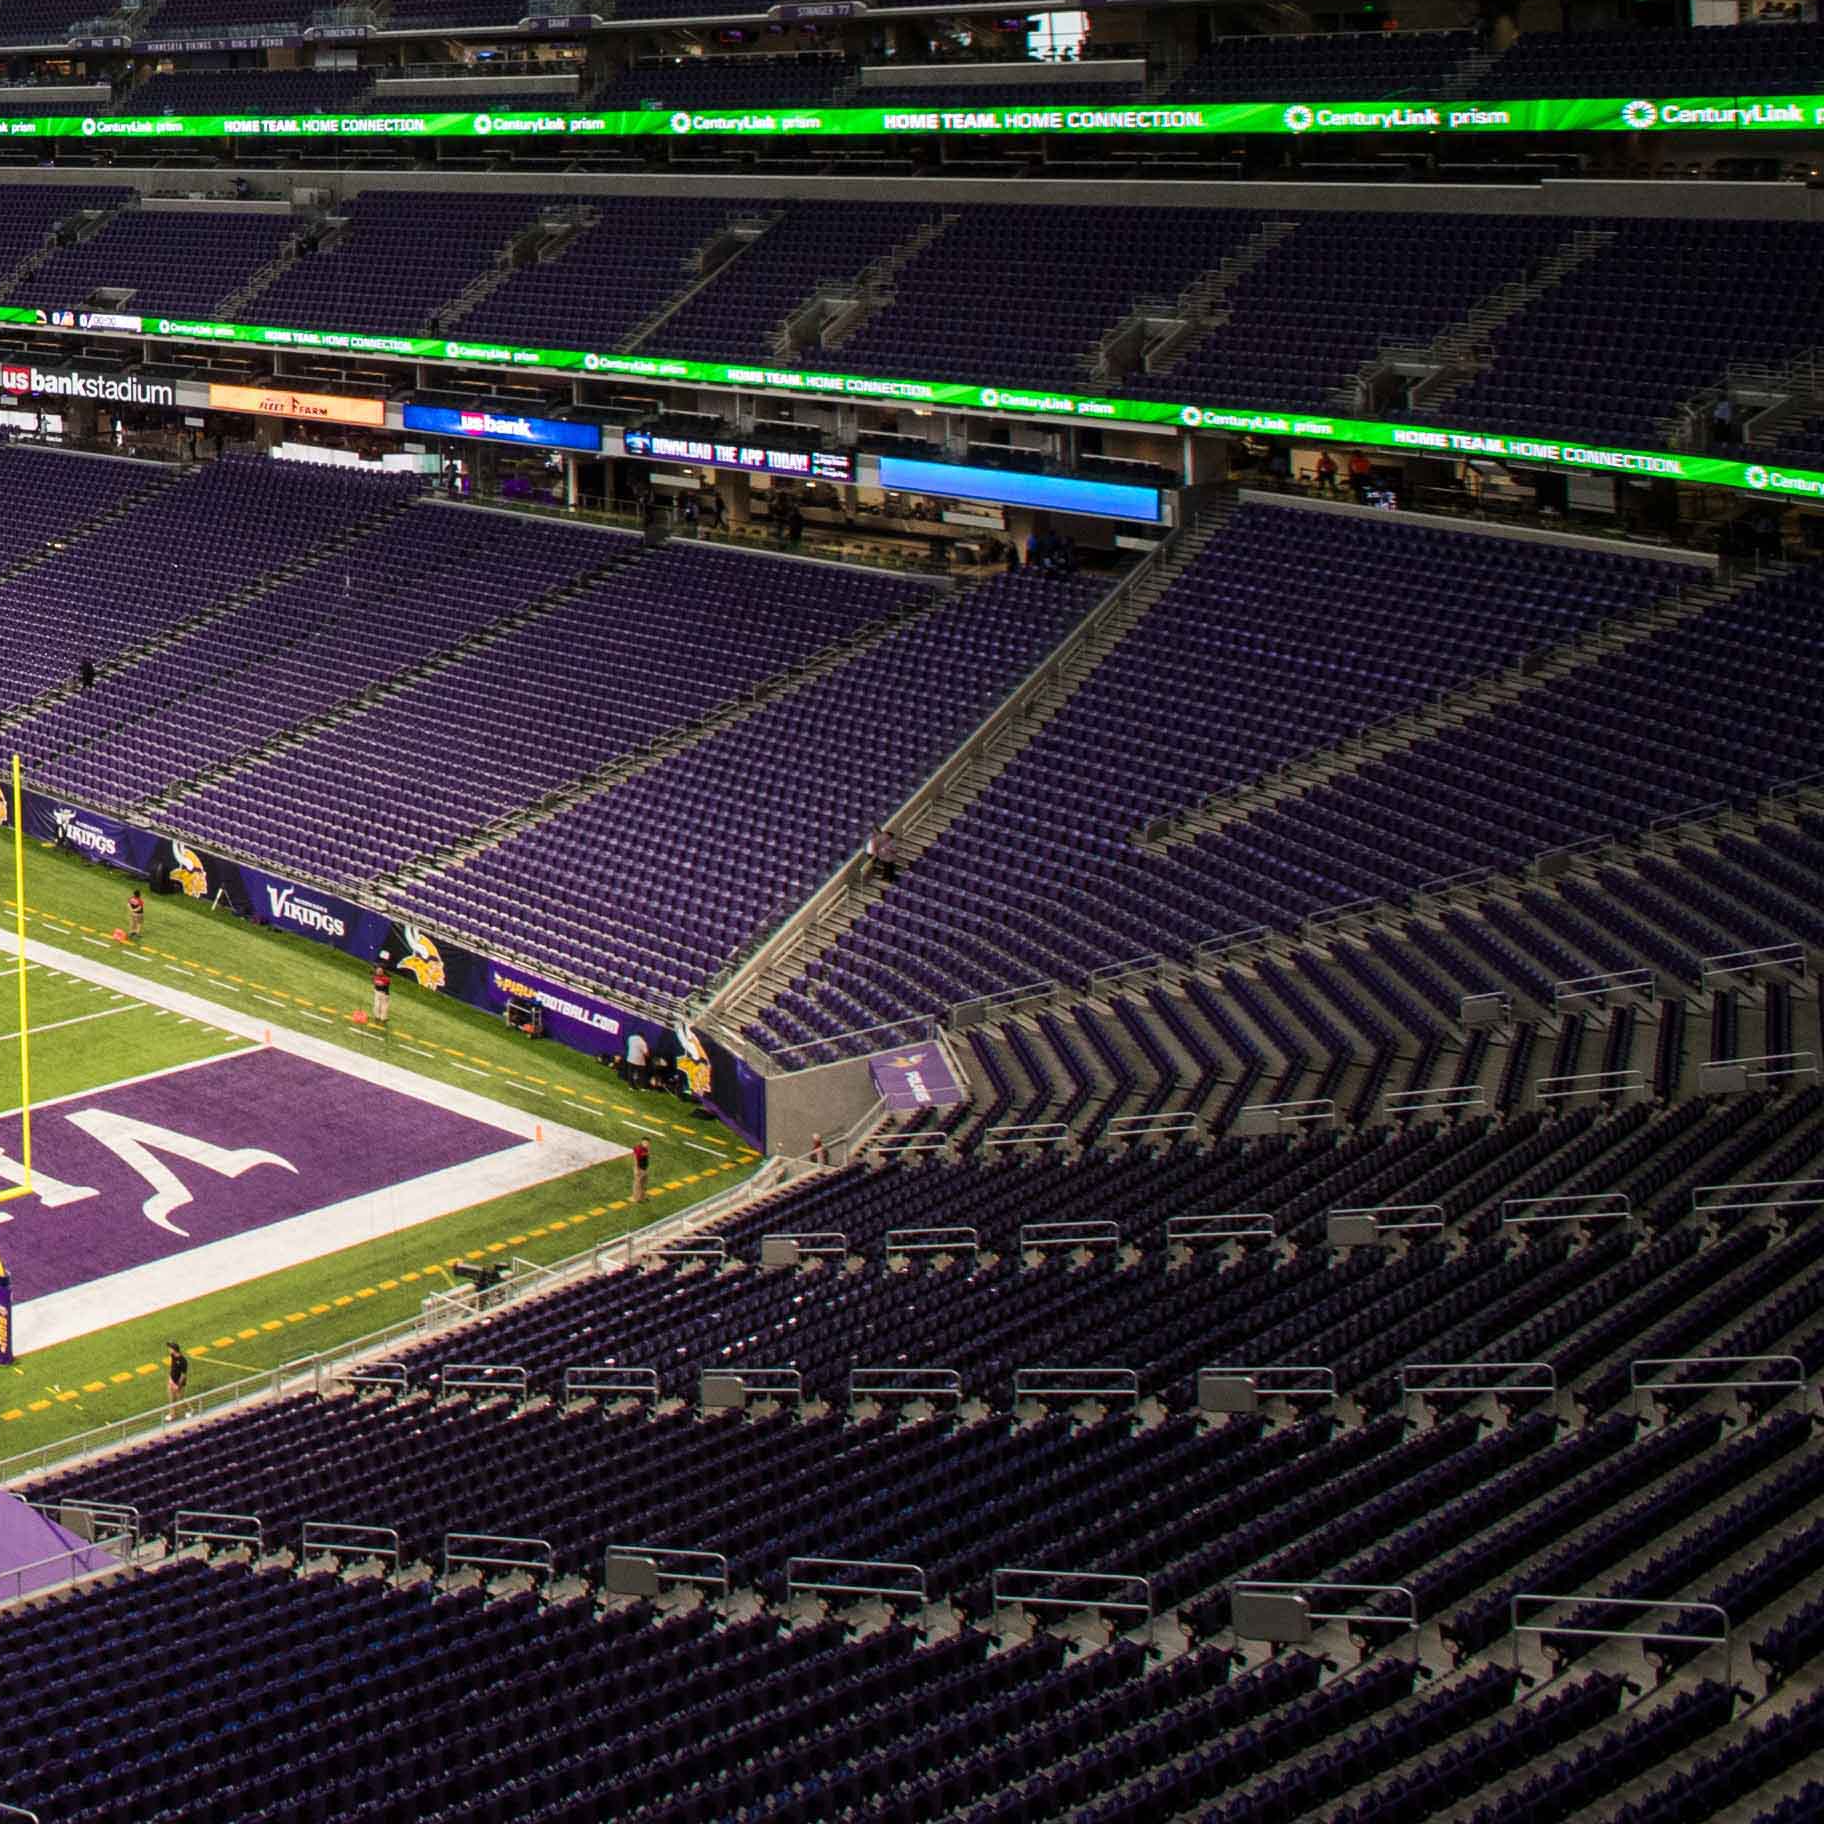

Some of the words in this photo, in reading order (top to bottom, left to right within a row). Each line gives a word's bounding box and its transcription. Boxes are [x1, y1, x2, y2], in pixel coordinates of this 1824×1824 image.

[883, 114, 938, 129] HOME
[1004, 113, 1061, 128] HOME
[1316, 109, 1438, 128] CenturyLink
[1449, 108, 1507, 127] prism
[1662, 104, 1802, 125] CenturyLink
[652, 438, 713, 461] DOWNLOAD
[714, 445, 738, 464] THE
[739, 448, 765, 466] APP
[1394, 430, 1449, 447] HOME
[1509, 442, 1558, 459] HOME
